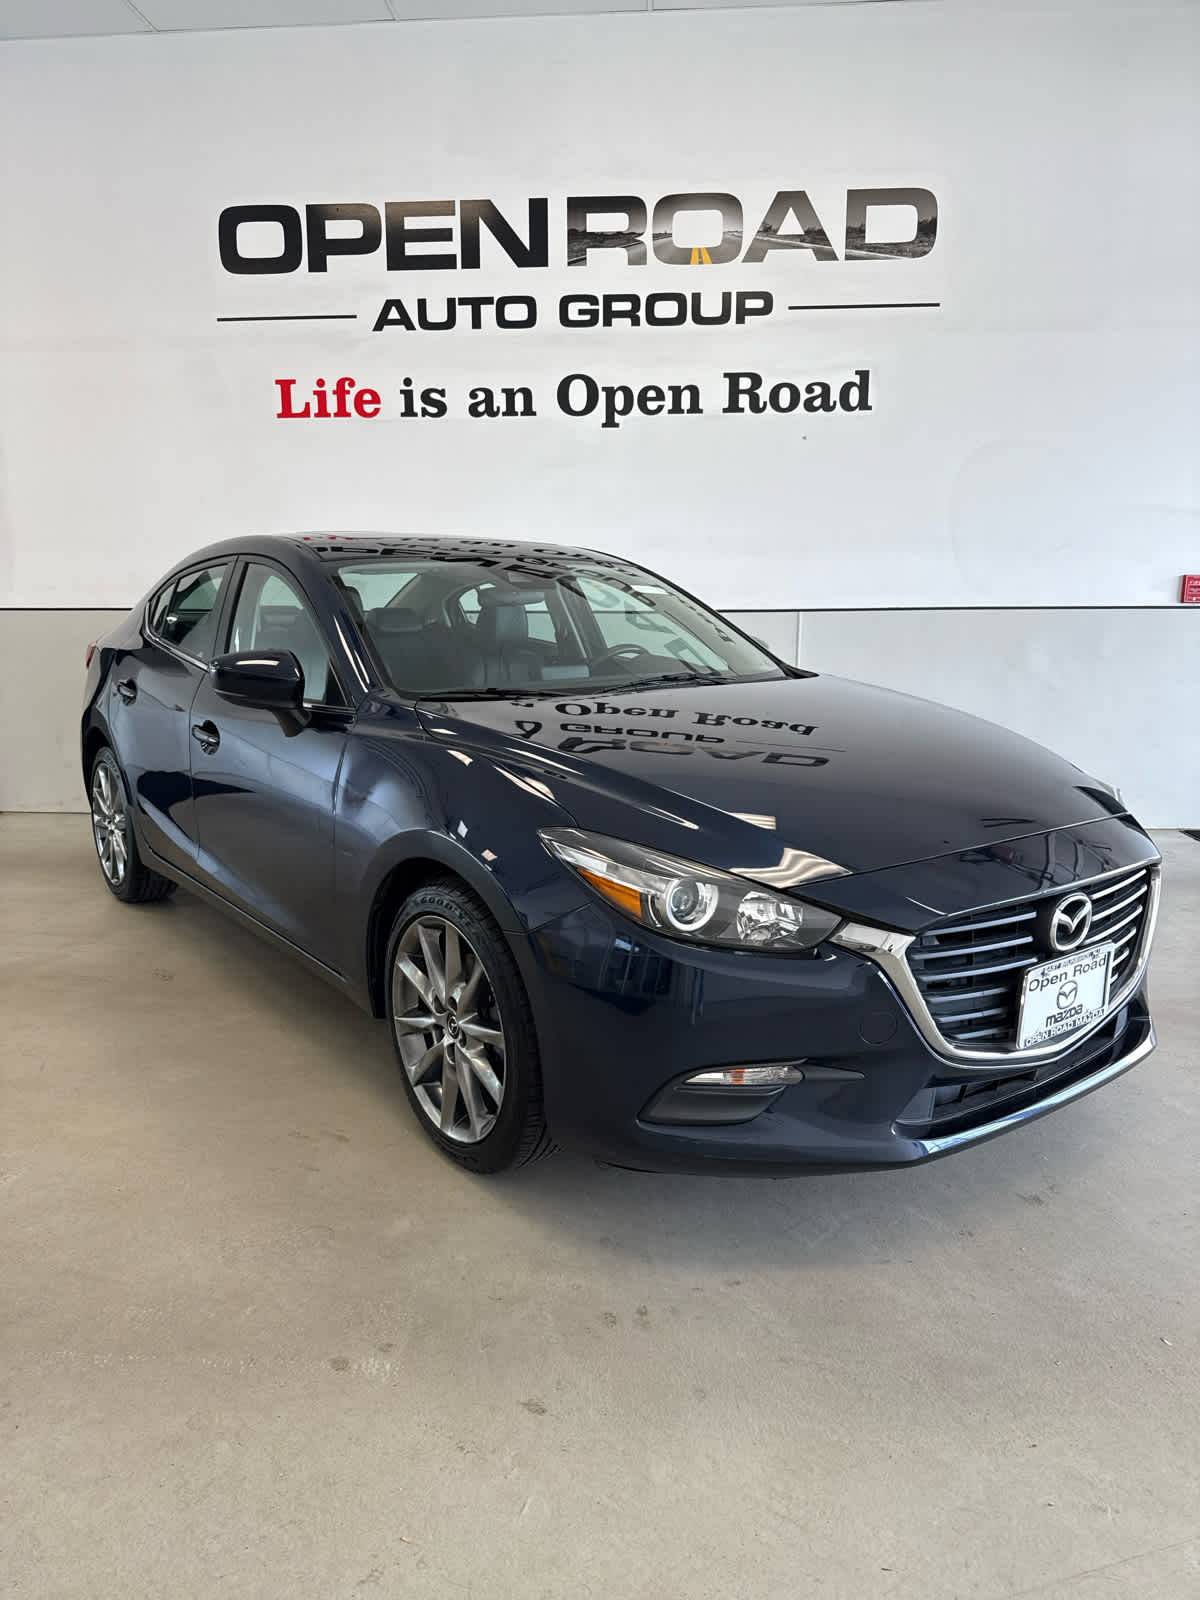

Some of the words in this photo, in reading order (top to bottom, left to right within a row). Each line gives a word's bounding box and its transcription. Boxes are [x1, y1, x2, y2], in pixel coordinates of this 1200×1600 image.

[218, 197, 550, 275] OPEN
[565, 187, 939, 267] ROAD
[372, 296, 538, 332] AUTO
[559, 291, 774, 329] GROUP
[275, 378, 382, 420] Life
[400, 378, 448, 419] is
[468, 388, 538, 419] an
[556, 374, 704, 429] Open
[722, 370, 873, 415] Road
[1028, 971, 1068, 992] Open
[1073, 956, 1107, 977] Road
